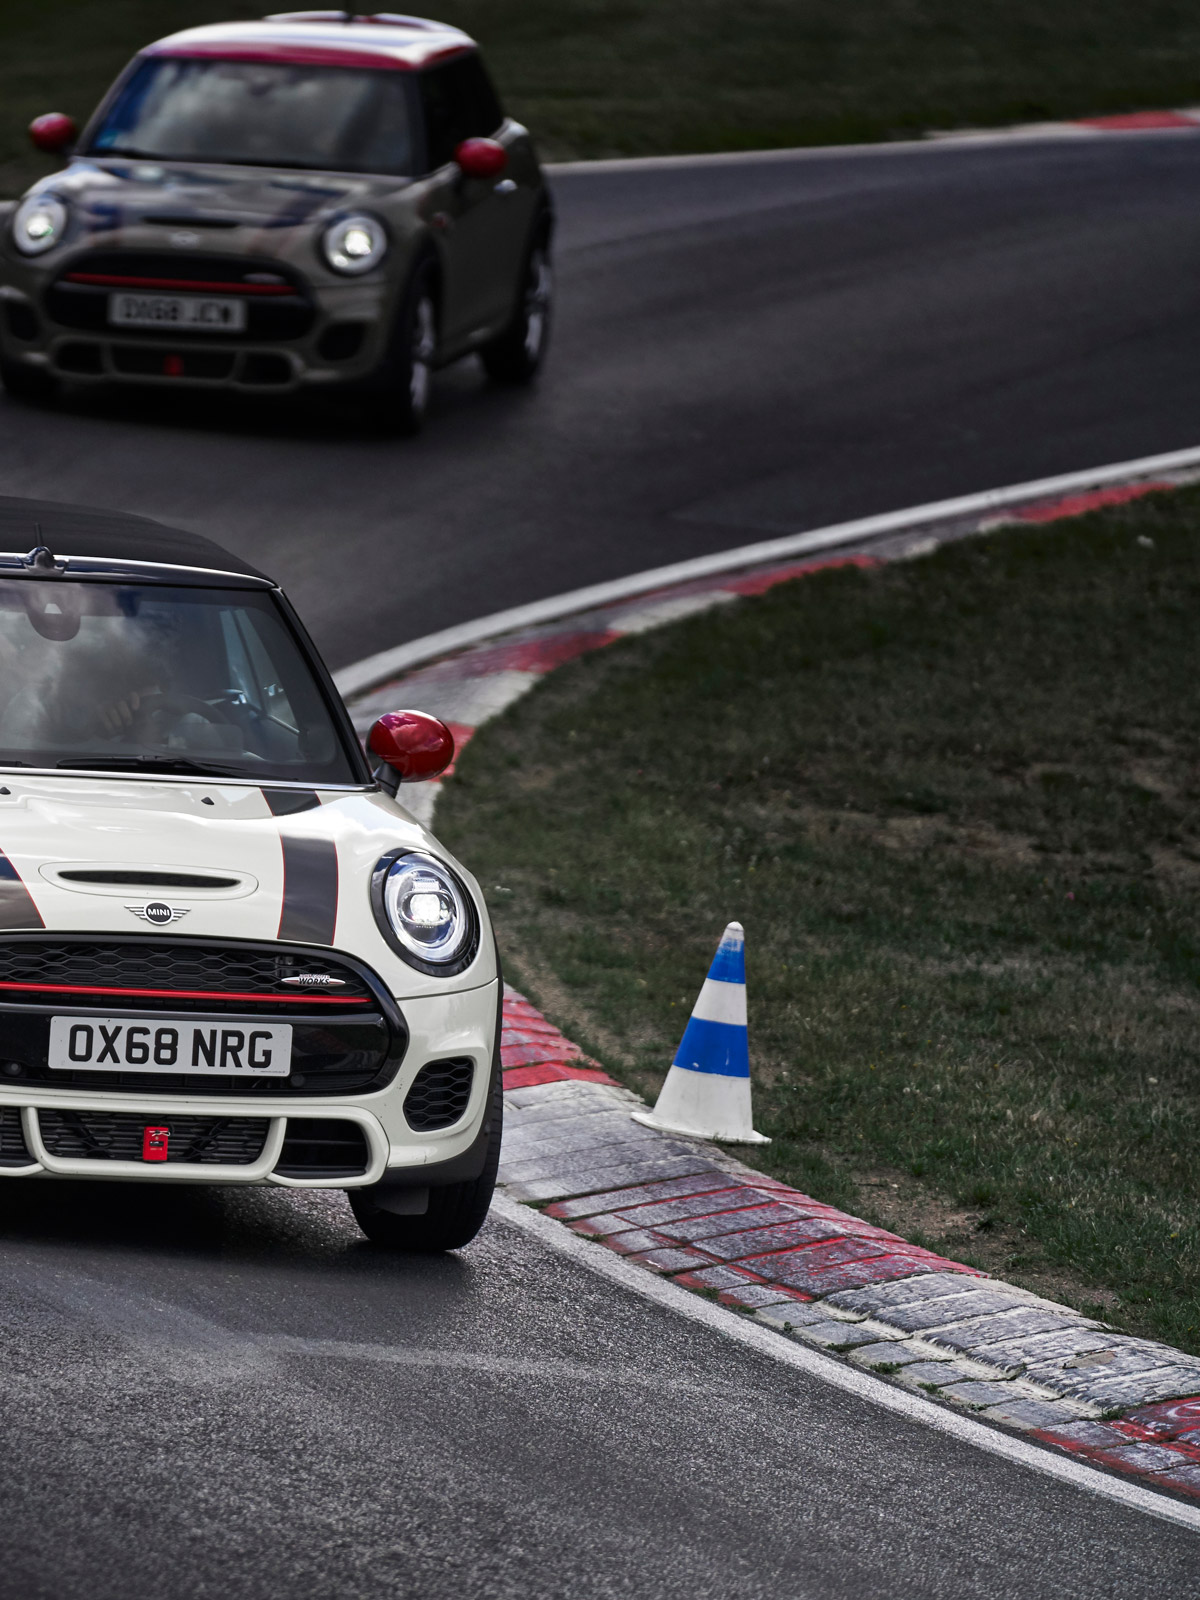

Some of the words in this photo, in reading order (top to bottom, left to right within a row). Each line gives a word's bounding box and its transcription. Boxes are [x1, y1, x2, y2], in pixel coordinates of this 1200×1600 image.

[147, 908, 171, 917] MINI
[299, 977, 330, 986] WORKS
[68, 1024, 179, 1066] OX68
[191, 1028, 274, 1069] NRG
